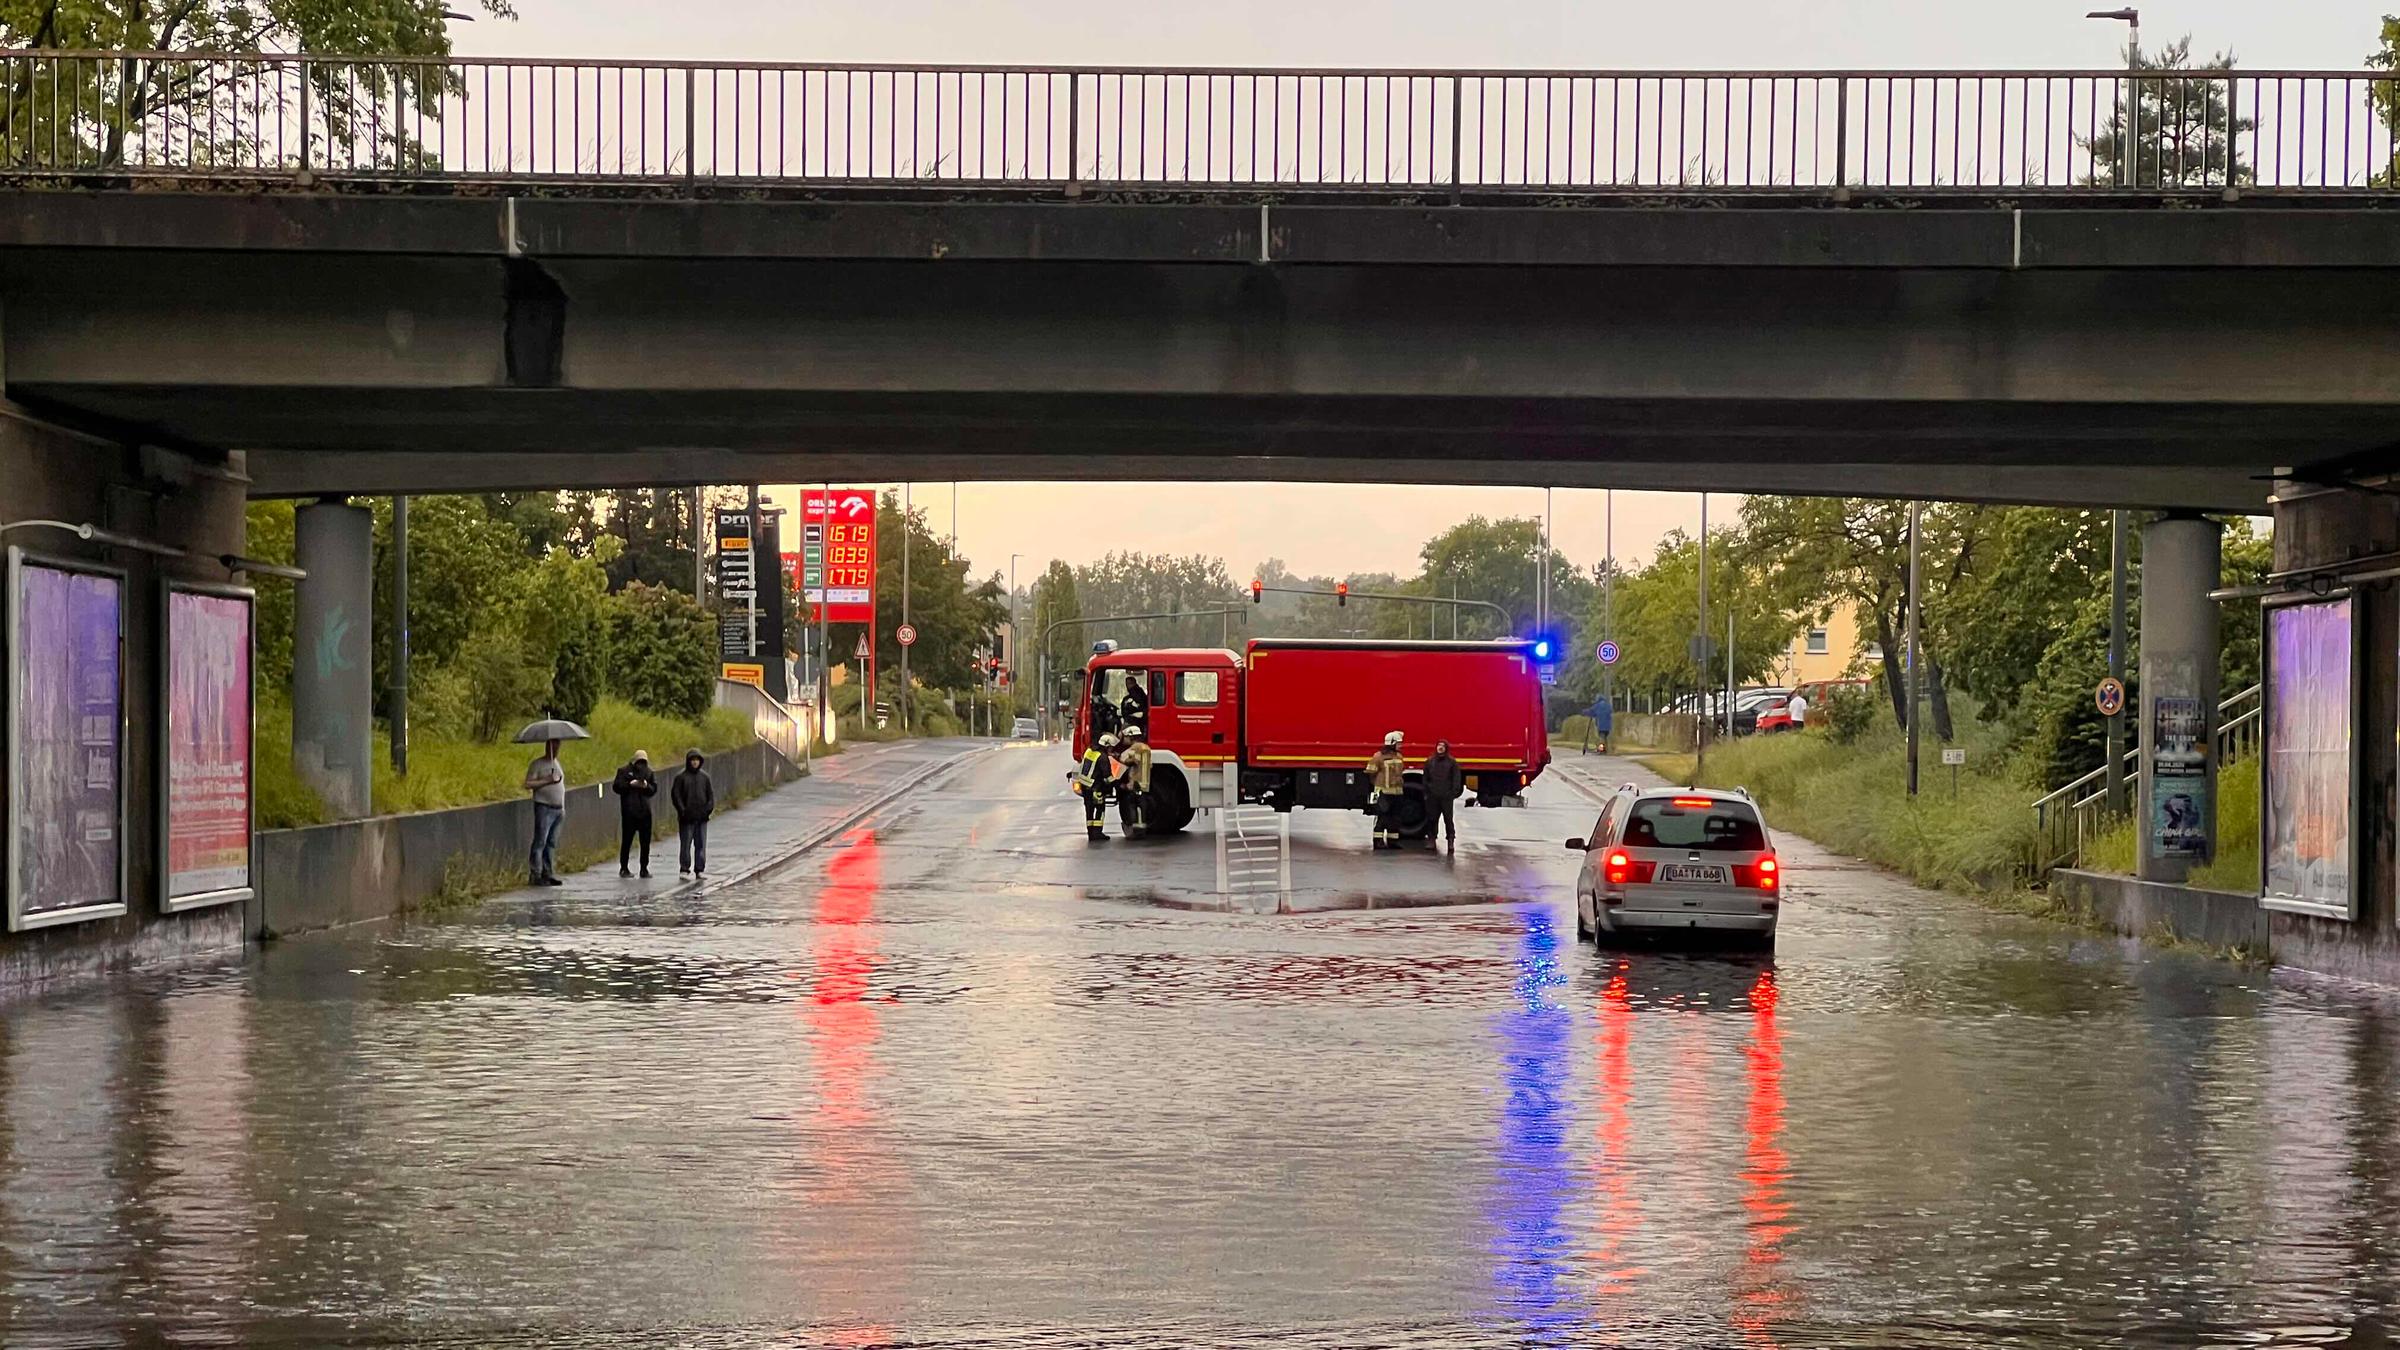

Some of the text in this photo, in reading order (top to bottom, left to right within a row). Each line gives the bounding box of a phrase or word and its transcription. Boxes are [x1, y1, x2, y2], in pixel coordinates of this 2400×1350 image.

[807, 499, 837, 507] ORLN
[901, 630, 912, 640] 50
[1602, 647, 1615, 658] 50
